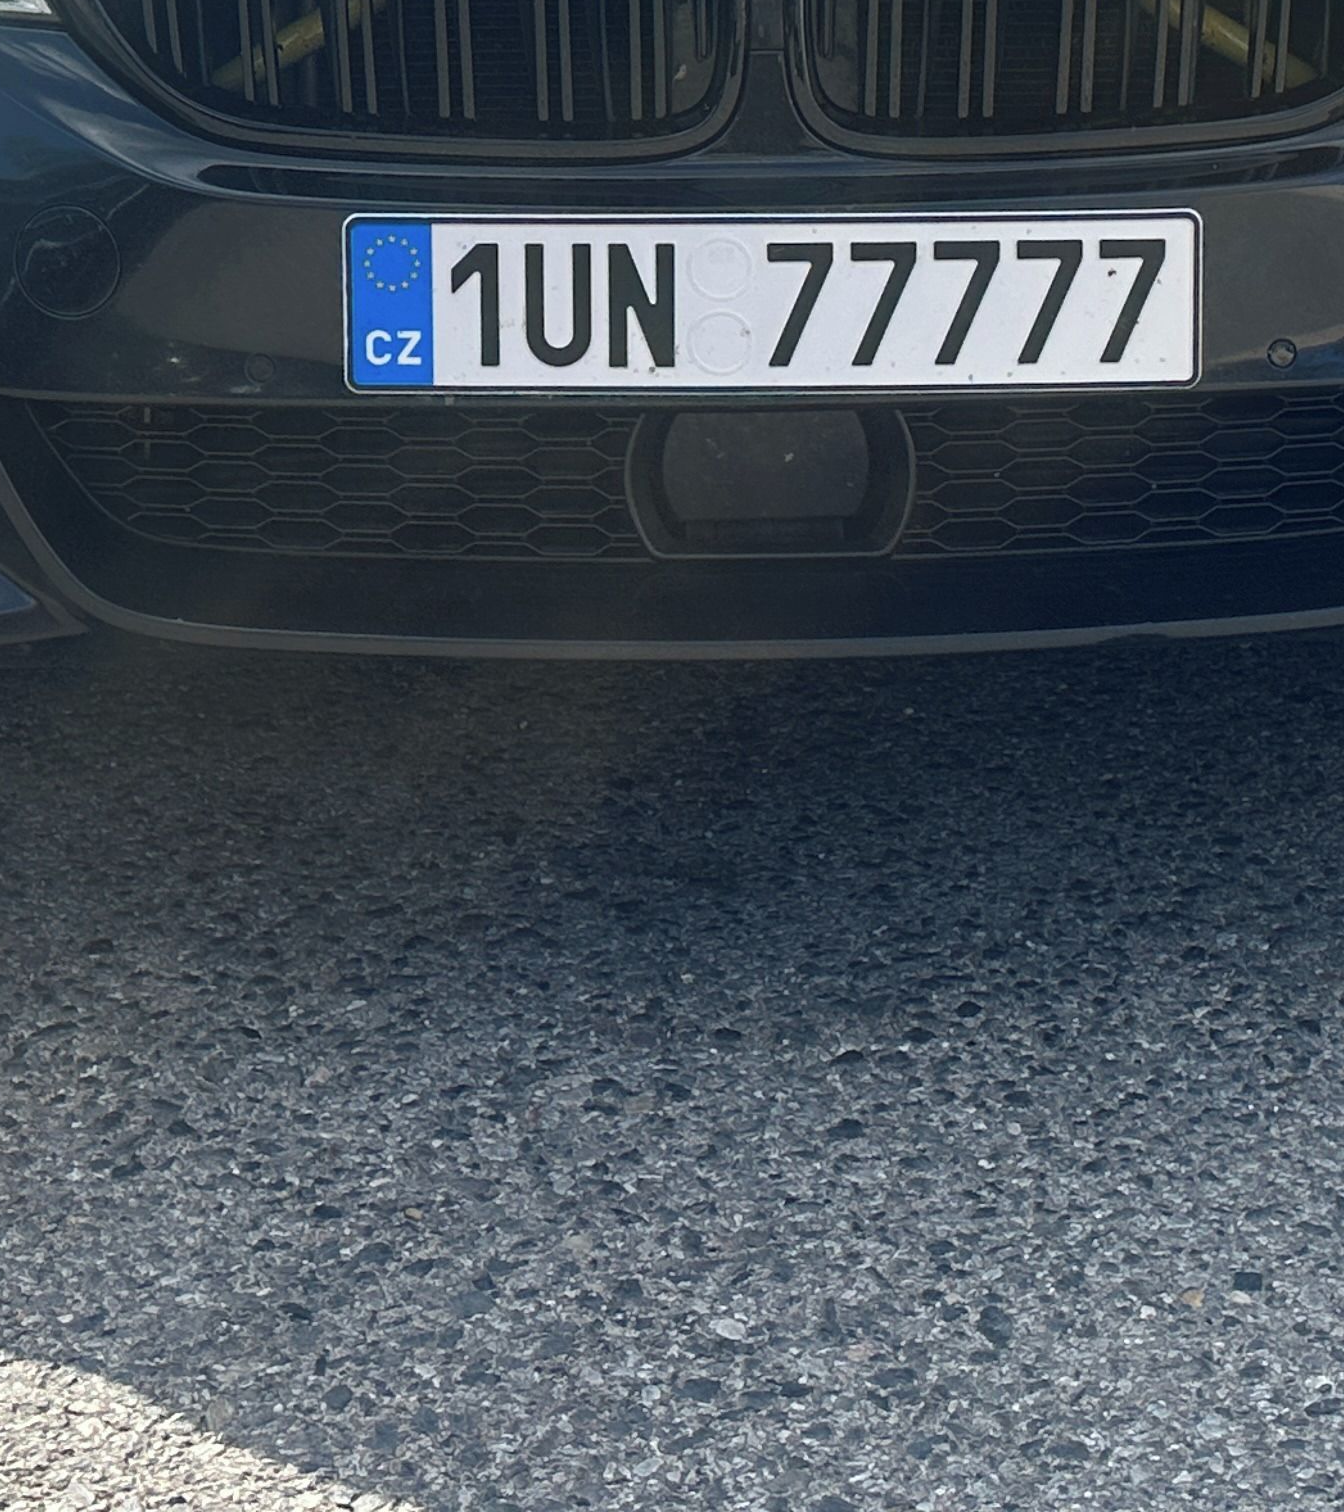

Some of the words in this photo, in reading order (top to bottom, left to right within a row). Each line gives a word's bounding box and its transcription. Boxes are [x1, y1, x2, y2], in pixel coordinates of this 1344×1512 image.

[451, 243, 675, 368] 1UN
[767, 239, 1167, 368] 77777
[365, 330, 423, 367] CZ
